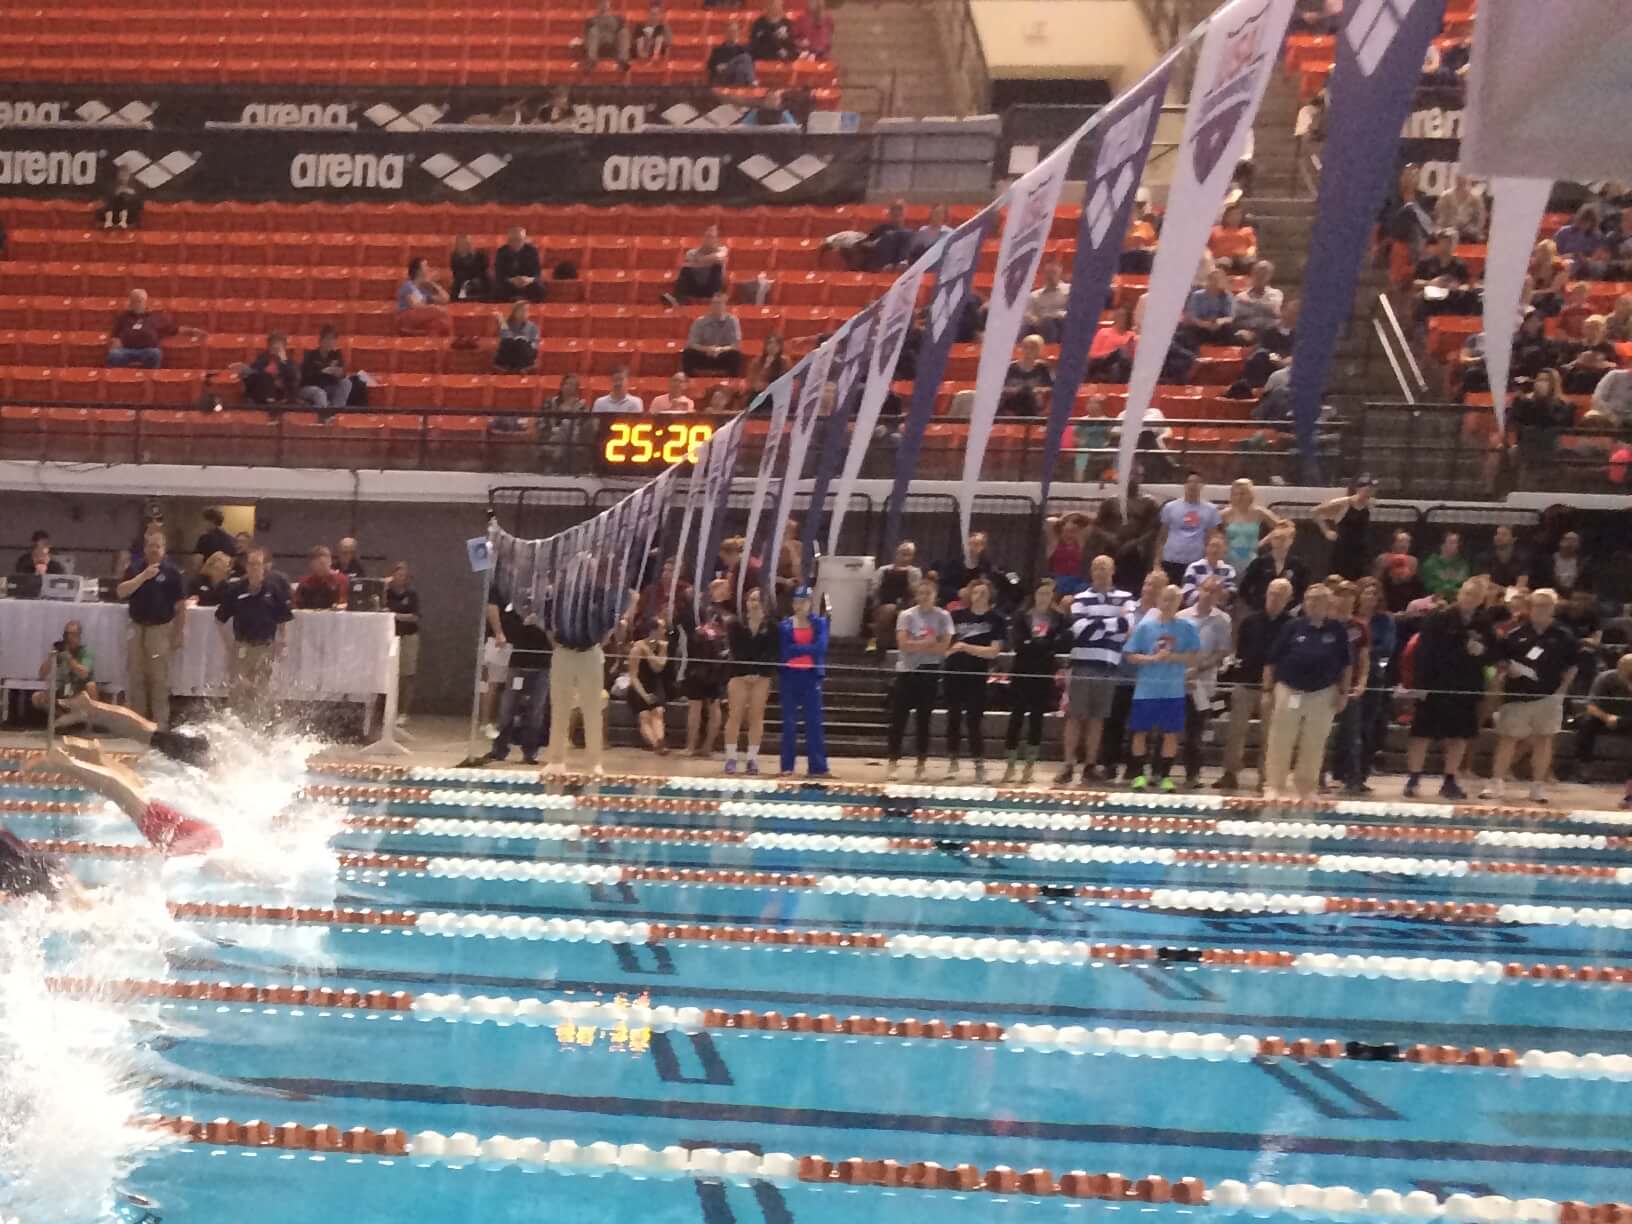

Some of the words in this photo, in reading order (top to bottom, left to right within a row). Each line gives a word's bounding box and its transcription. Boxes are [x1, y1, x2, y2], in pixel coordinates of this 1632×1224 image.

[240, 103, 348, 129] arena
[572, 104, 647, 134] ena
[290, 153, 405, 190] arena
[602, 155, 721, 192] arena
